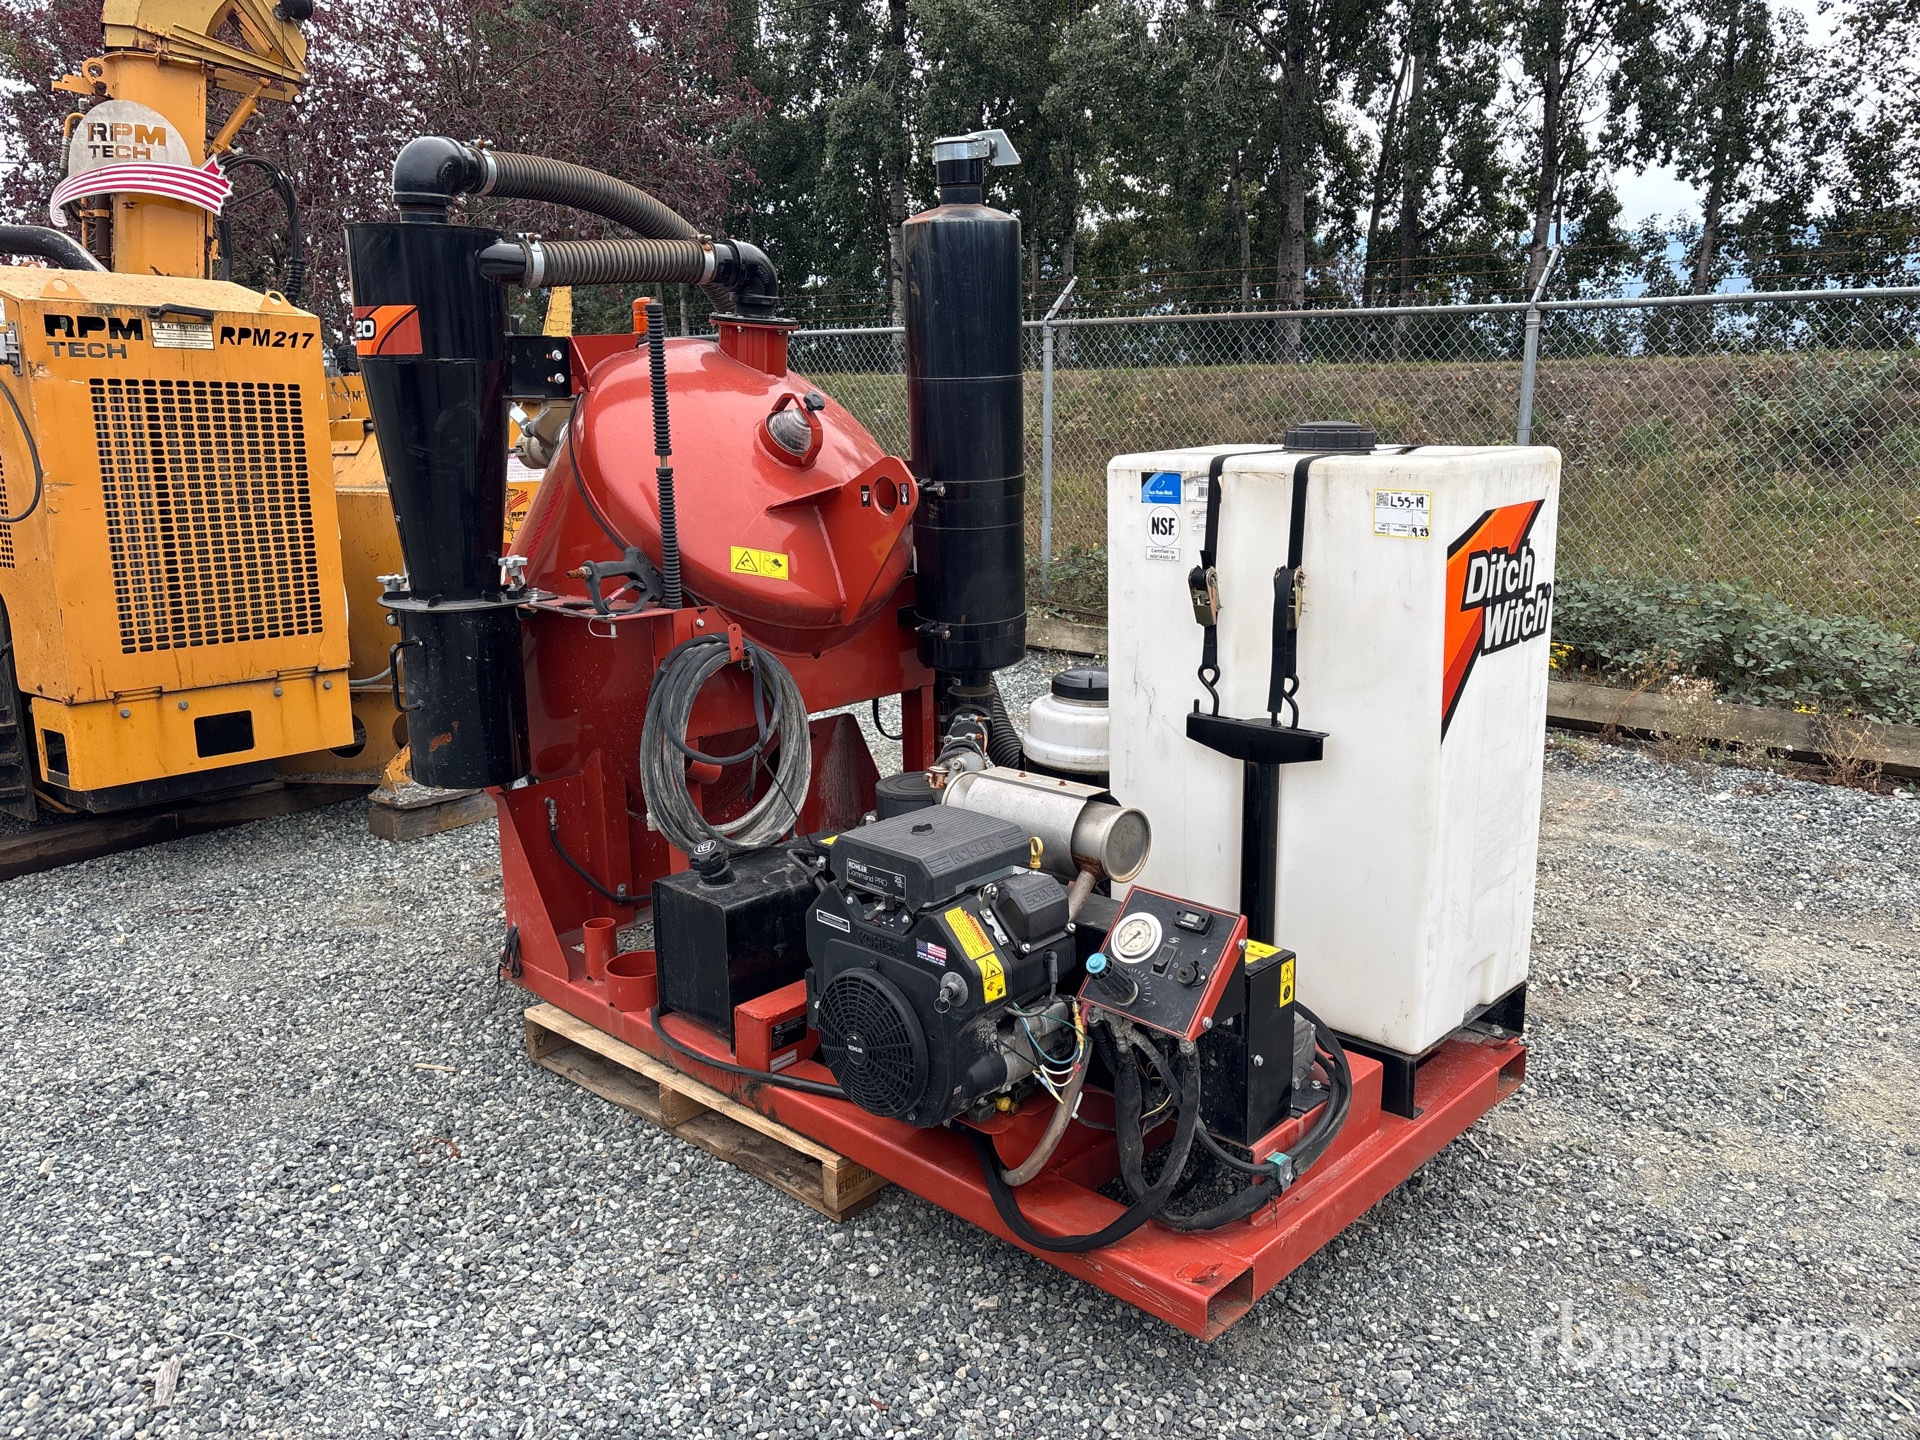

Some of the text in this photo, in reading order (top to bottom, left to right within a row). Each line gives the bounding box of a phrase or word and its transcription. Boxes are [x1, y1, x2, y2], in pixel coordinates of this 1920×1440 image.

[87, 122, 167, 147] RPM
[87, 144, 151, 160] TECH
[43, 314, 144, 341] RPM
[219, 325, 315, 349] RPM217
[46, 341, 127, 359] TECH
[1390, 495, 1424, 508] L55-19
[1151, 516, 1175, 536] NSF
[1411, 526, 1429, 538] 9.23
[1465, 545, 1533, 604] Ditch
[1484, 589, 1547, 650] Witch
[948, 839, 999, 865] KOHLER
[848, 861, 868, 874] KOHLER
[848, 868, 874, 882] Command
[874, 876, 888, 887] PRO
[968, 917, 988, 946] WARNING
